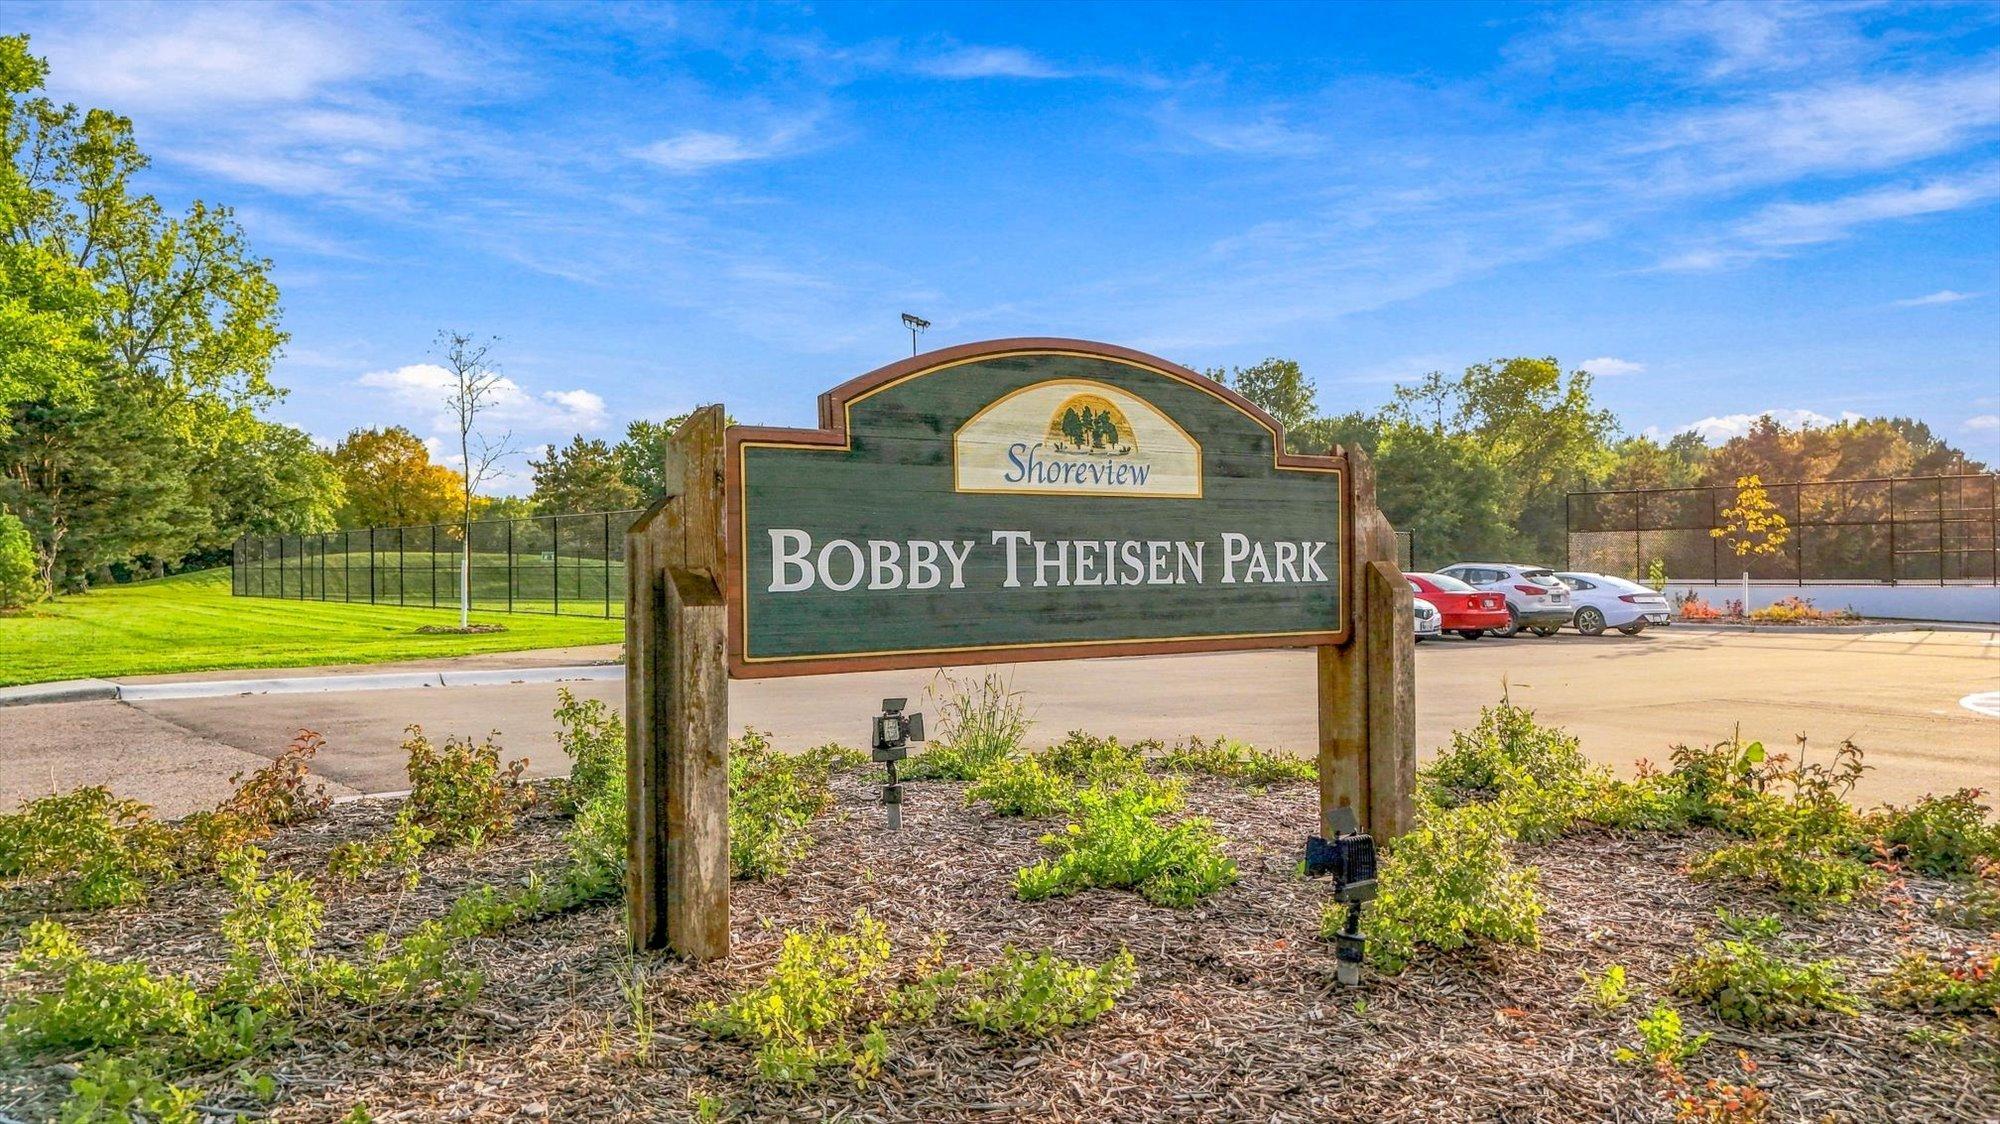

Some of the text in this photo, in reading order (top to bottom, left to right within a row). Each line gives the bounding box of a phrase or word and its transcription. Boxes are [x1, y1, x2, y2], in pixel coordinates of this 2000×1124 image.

[1004, 443, 1150, 486] Shoreview
[768, 528, 1328, 592] BOBBY THEISEN PARK
